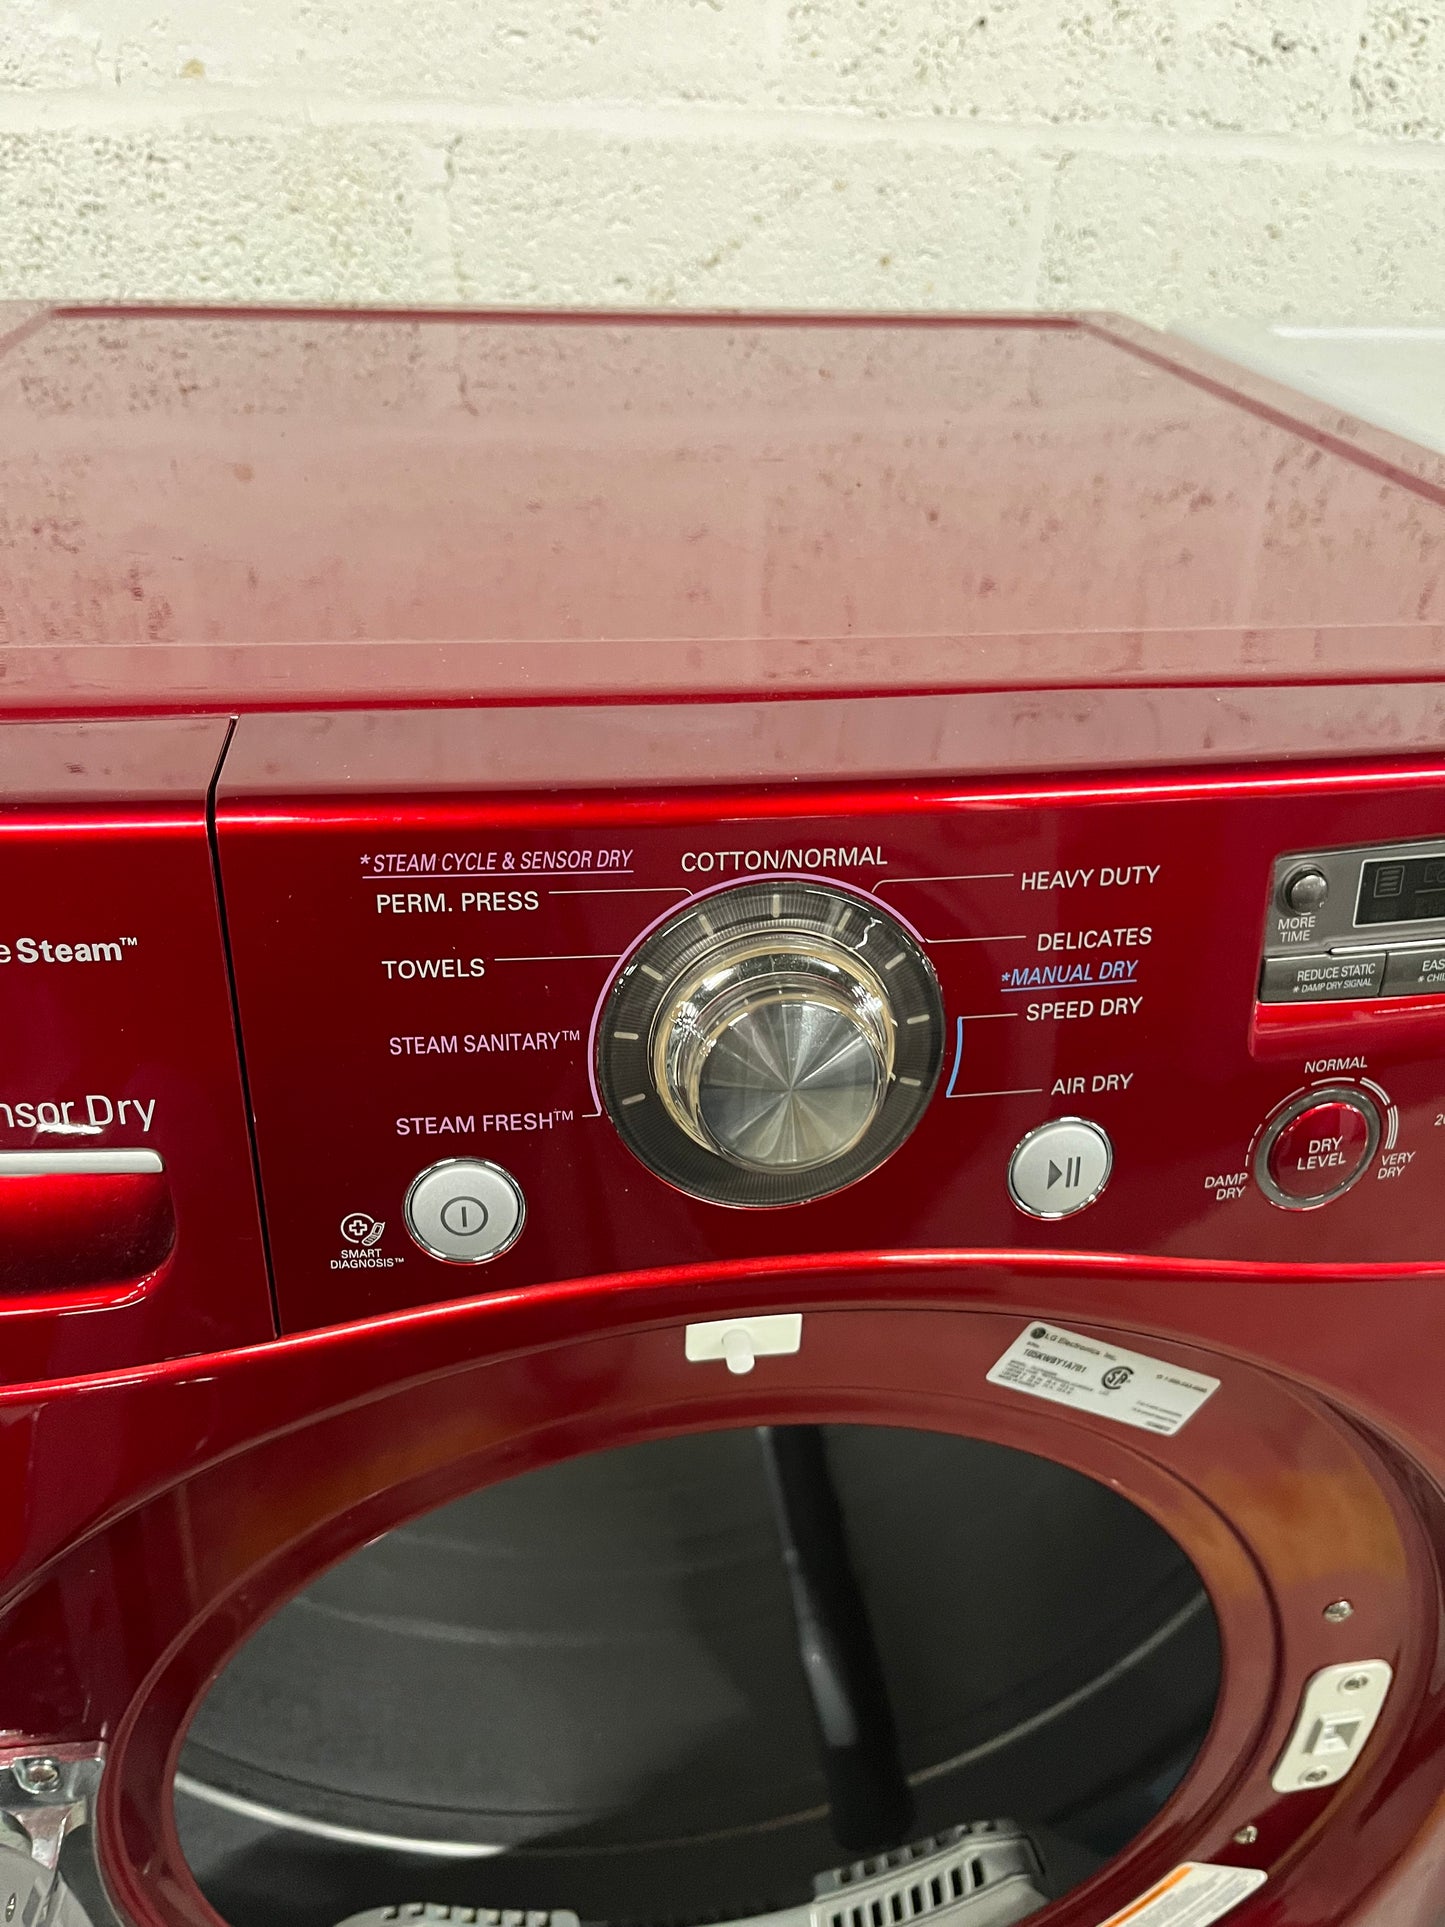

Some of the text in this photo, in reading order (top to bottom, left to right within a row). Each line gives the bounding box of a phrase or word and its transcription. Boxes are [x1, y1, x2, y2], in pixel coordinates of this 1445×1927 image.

[441, 852, 498, 872] CYCLE
[502, 851, 516, 871] &
[520, 850, 592, 870] SENSOR
[597, 849, 634, 868] DRY
[680, 846, 888, 873] COTTON/NORMAL
[1021, 864, 1161, 891] HEAVY DUTY
[377, 890, 540, 914] PERM. PRESS
[1278, 916, 1316, 930] MORE
[1036, 926, 1153, 952] DELICATES
[1280, 930, 1311, 943] TIME
[381, 957, 486, 980] TOWELS
[1099, 960, 1139, 980] DRY
[1296, 963, 1376, 982] REDUCE STATIC
[1301, 978, 1373, 993] DAMP DRY SIGNAL
[1026, 996, 1144, 1021] SPEED DRY
[390, 1035, 458, 1056] STEAM
[1304, 1056, 1368, 1074] NORMAL
[1050, 1073, 1134, 1096] AIR DRY
[85, 1094, 156, 1132] Dry
[396, 1115, 475, 1136] STEAM
[1308, 1135, 1343, 1154] DRY
[1297, 1152, 1346, 1171] LEVEL
[1381, 1151, 1416, 1166] VERY
[1204, 1172, 1248, 1189] DAMP
[1377, 1165, 1405, 1180] DRY
[1215, 1186, 1246, 1201] DRY
[341, 1248, 382, 1259] SMART
